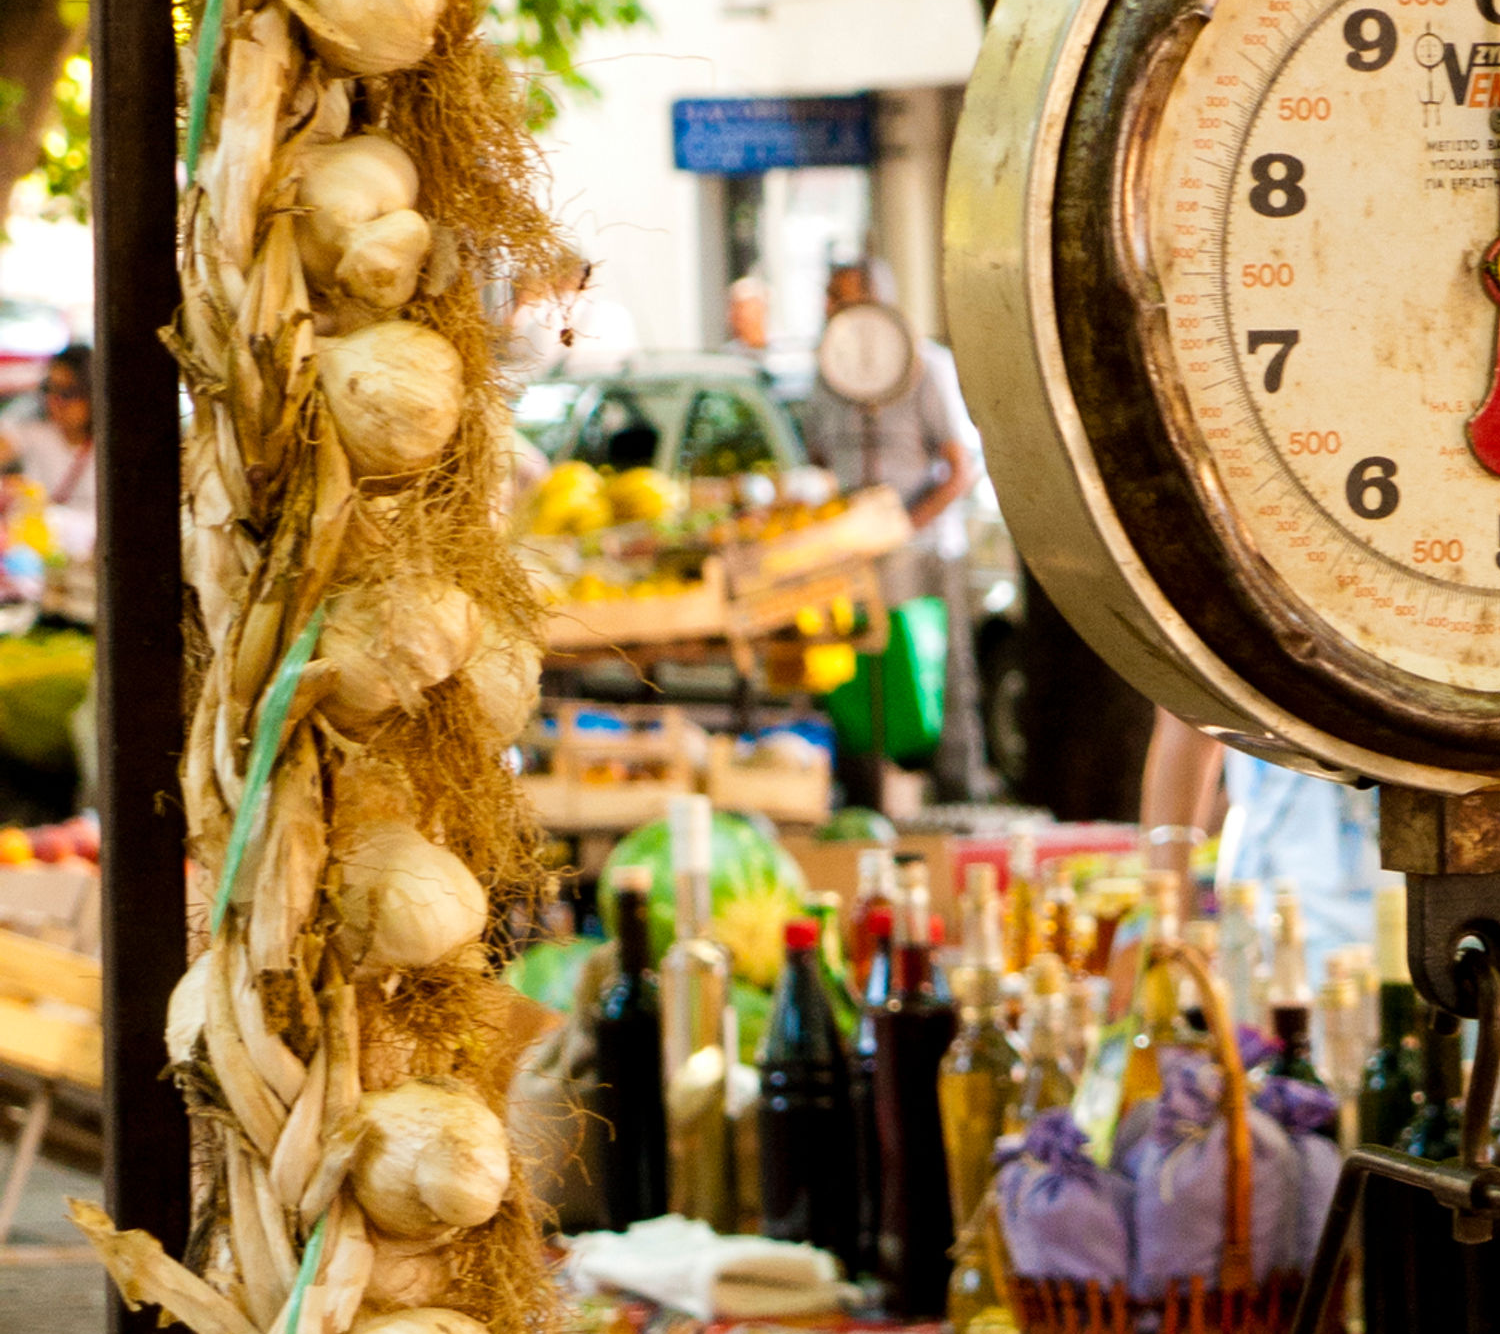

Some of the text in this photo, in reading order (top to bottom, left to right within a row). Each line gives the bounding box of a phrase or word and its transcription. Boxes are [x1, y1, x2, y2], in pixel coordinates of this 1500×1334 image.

[1342, 7, 1397, 72] 9
[1278, 96, 1332, 121] 500
[1249, 152, 1307, 217] 8
[1241, 262, 1295, 288] 500
[1247, 329, 1300, 394] 7
[1288, 430, 1342, 455] 500
[1346, 455, 1400, 519] 6
[1411, 539, 1464, 564] 500
